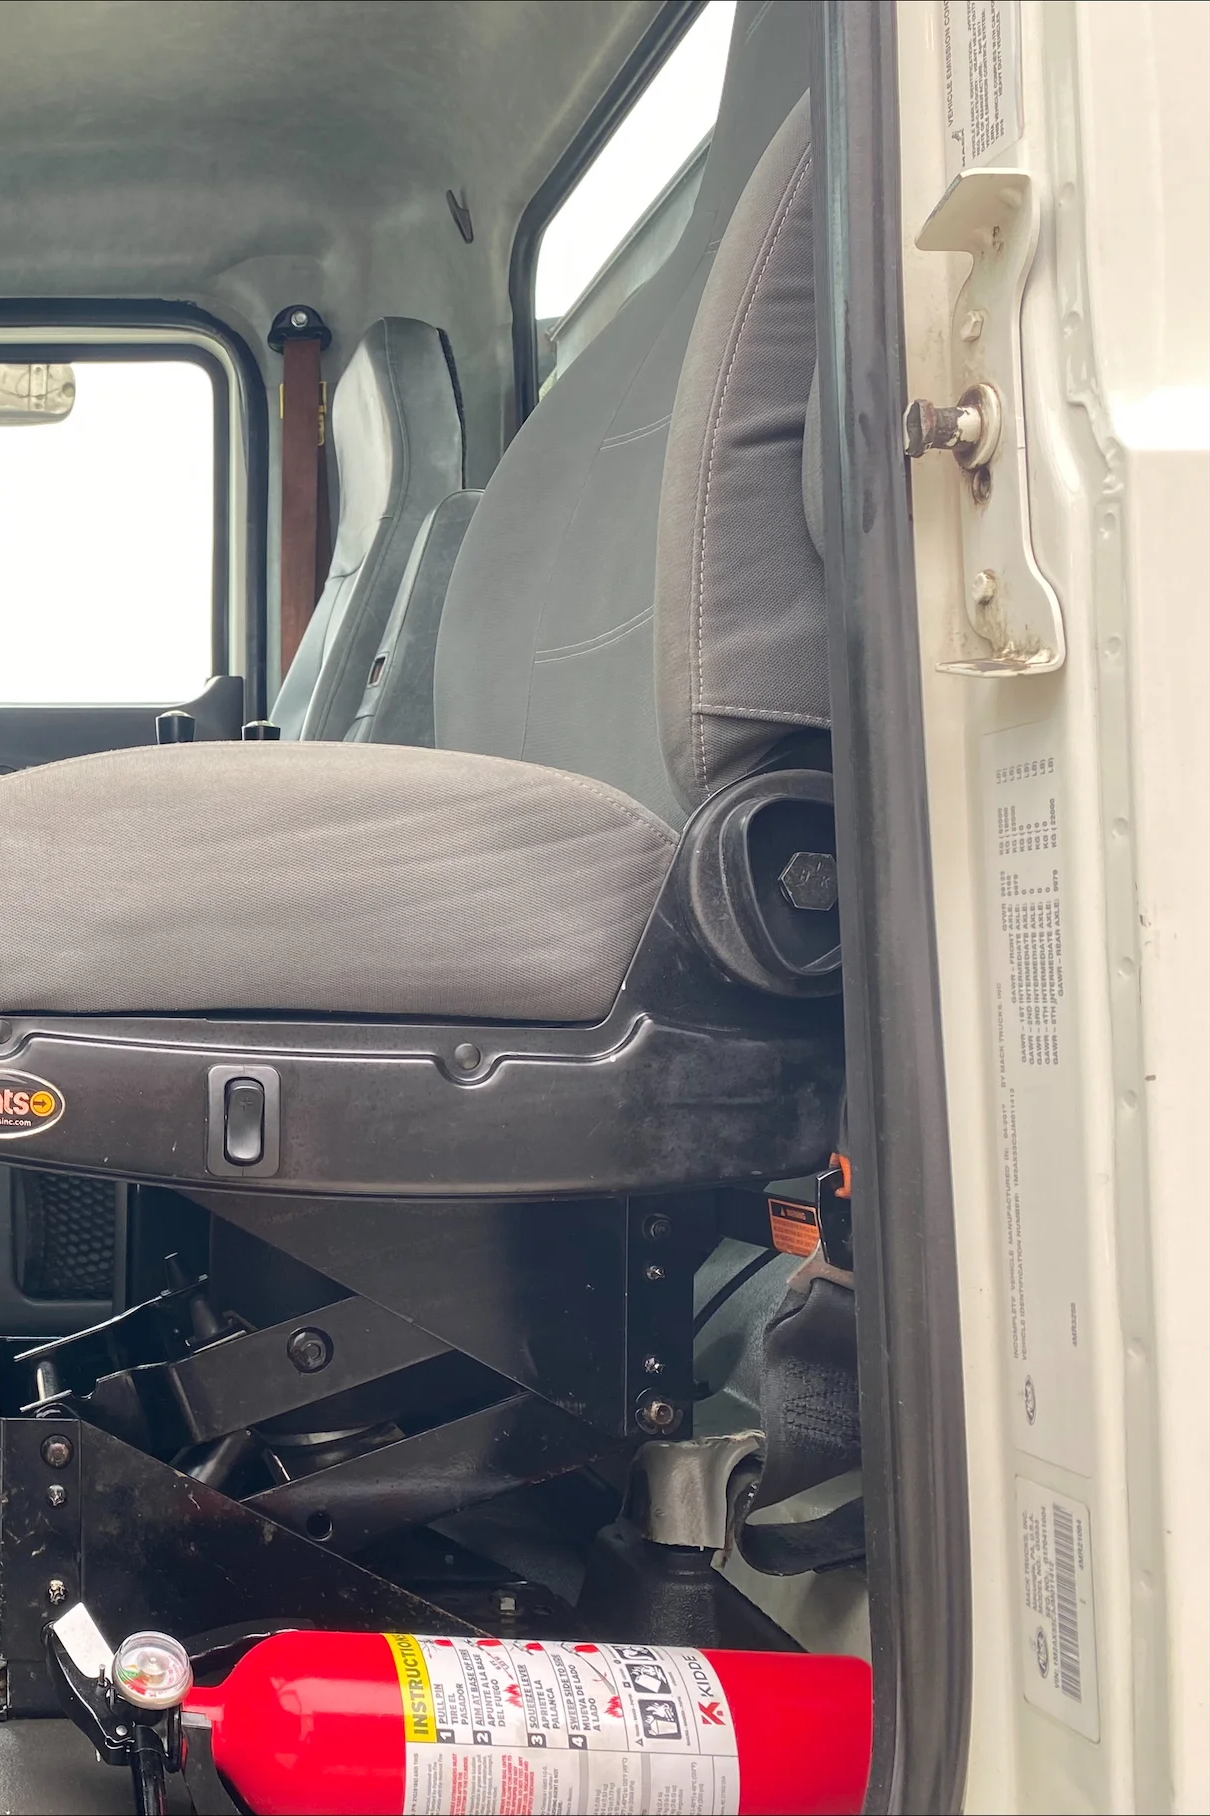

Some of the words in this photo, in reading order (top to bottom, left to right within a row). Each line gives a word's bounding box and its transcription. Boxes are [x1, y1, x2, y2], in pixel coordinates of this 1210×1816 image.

[944, 27, 952, 80] EMISSION
[999, 842, 1004, 856] KG
[1005, 841, 1010, 854] KG
[1012, 840, 1017, 853] KG
[1020, 838, 1025, 852] KG
[1027, 837, 1032, 851] KG
[1035, 836, 1040, 850] KG
[1043, 835, 1048, 849] KG
[1051, 834, 1057, 848] KG
[1016, 933, 1024, 1004] INTERMEDIATE
[1023, 932, 1031, 1003] INTERMEDIATE
[1031, 932, 1039, 1003] INTERMEDIATE
[1039, 931, 1047, 1003] INTERMEDIATE
[1047, 931, 1057, 1004] INTERMEDIATE
[998, 1045, 1006, 1073] MACK
[1017, 1240, 1025, 1317] IDENTIFICATION
[458, 1649, 470, 1661] FIRE
[473, 1654, 484, 1670] BASE
[551, 1654, 562, 1667] SIDE
[464, 1662, 473, 1671] OF
[517, 1664, 530, 1686] LEVER
[557, 1668, 566, 1677] TO
[568, 1664, 581, 1684] LADO
[467, 1672, 478, 1693] BASE
[479, 1671, 487, 1681] LA
[534, 1680, 542, 1689] LA
[682, 1655, 714, 1698] KIDDE
[433, 1683, 443, 1698] PIN
[491, 1679, 503, 1707] FUEGO
[561, 1679, 572, 1697] SIDE
[575, 1686, 583, 1696] DE
[448, 1693, 456, 1703] EL
[456, 1683, 469, 1725] PASADOR
[472, 1694, 480, 1704] AT
[437, 1701, 447, 1724] PULL
[449, 1705, 459, 1725] TIRE
[474, 1708, 483, 1726] AIM
[483, 1690, 496, 1727] APUNTE
[525, 1688, 538, 1729] SQUEEZE
[536, 1691, 550, 1729] APRIETE
[546, 1687, 560, 1729] PALANCA
[567, 1699, 578, 1731] SWEEP
[580, 1698, 591, 1731] MUEVA
[588, 1698, 600, 1722] LADO
[496, 1709, 506, 1727] DEL
[440, 1731, 452, 1740] 1
[477, 1732, 489, 1743] 2
[531, 1735, 542, 1746] 3
[571, 1737, 584, 1747] 4
